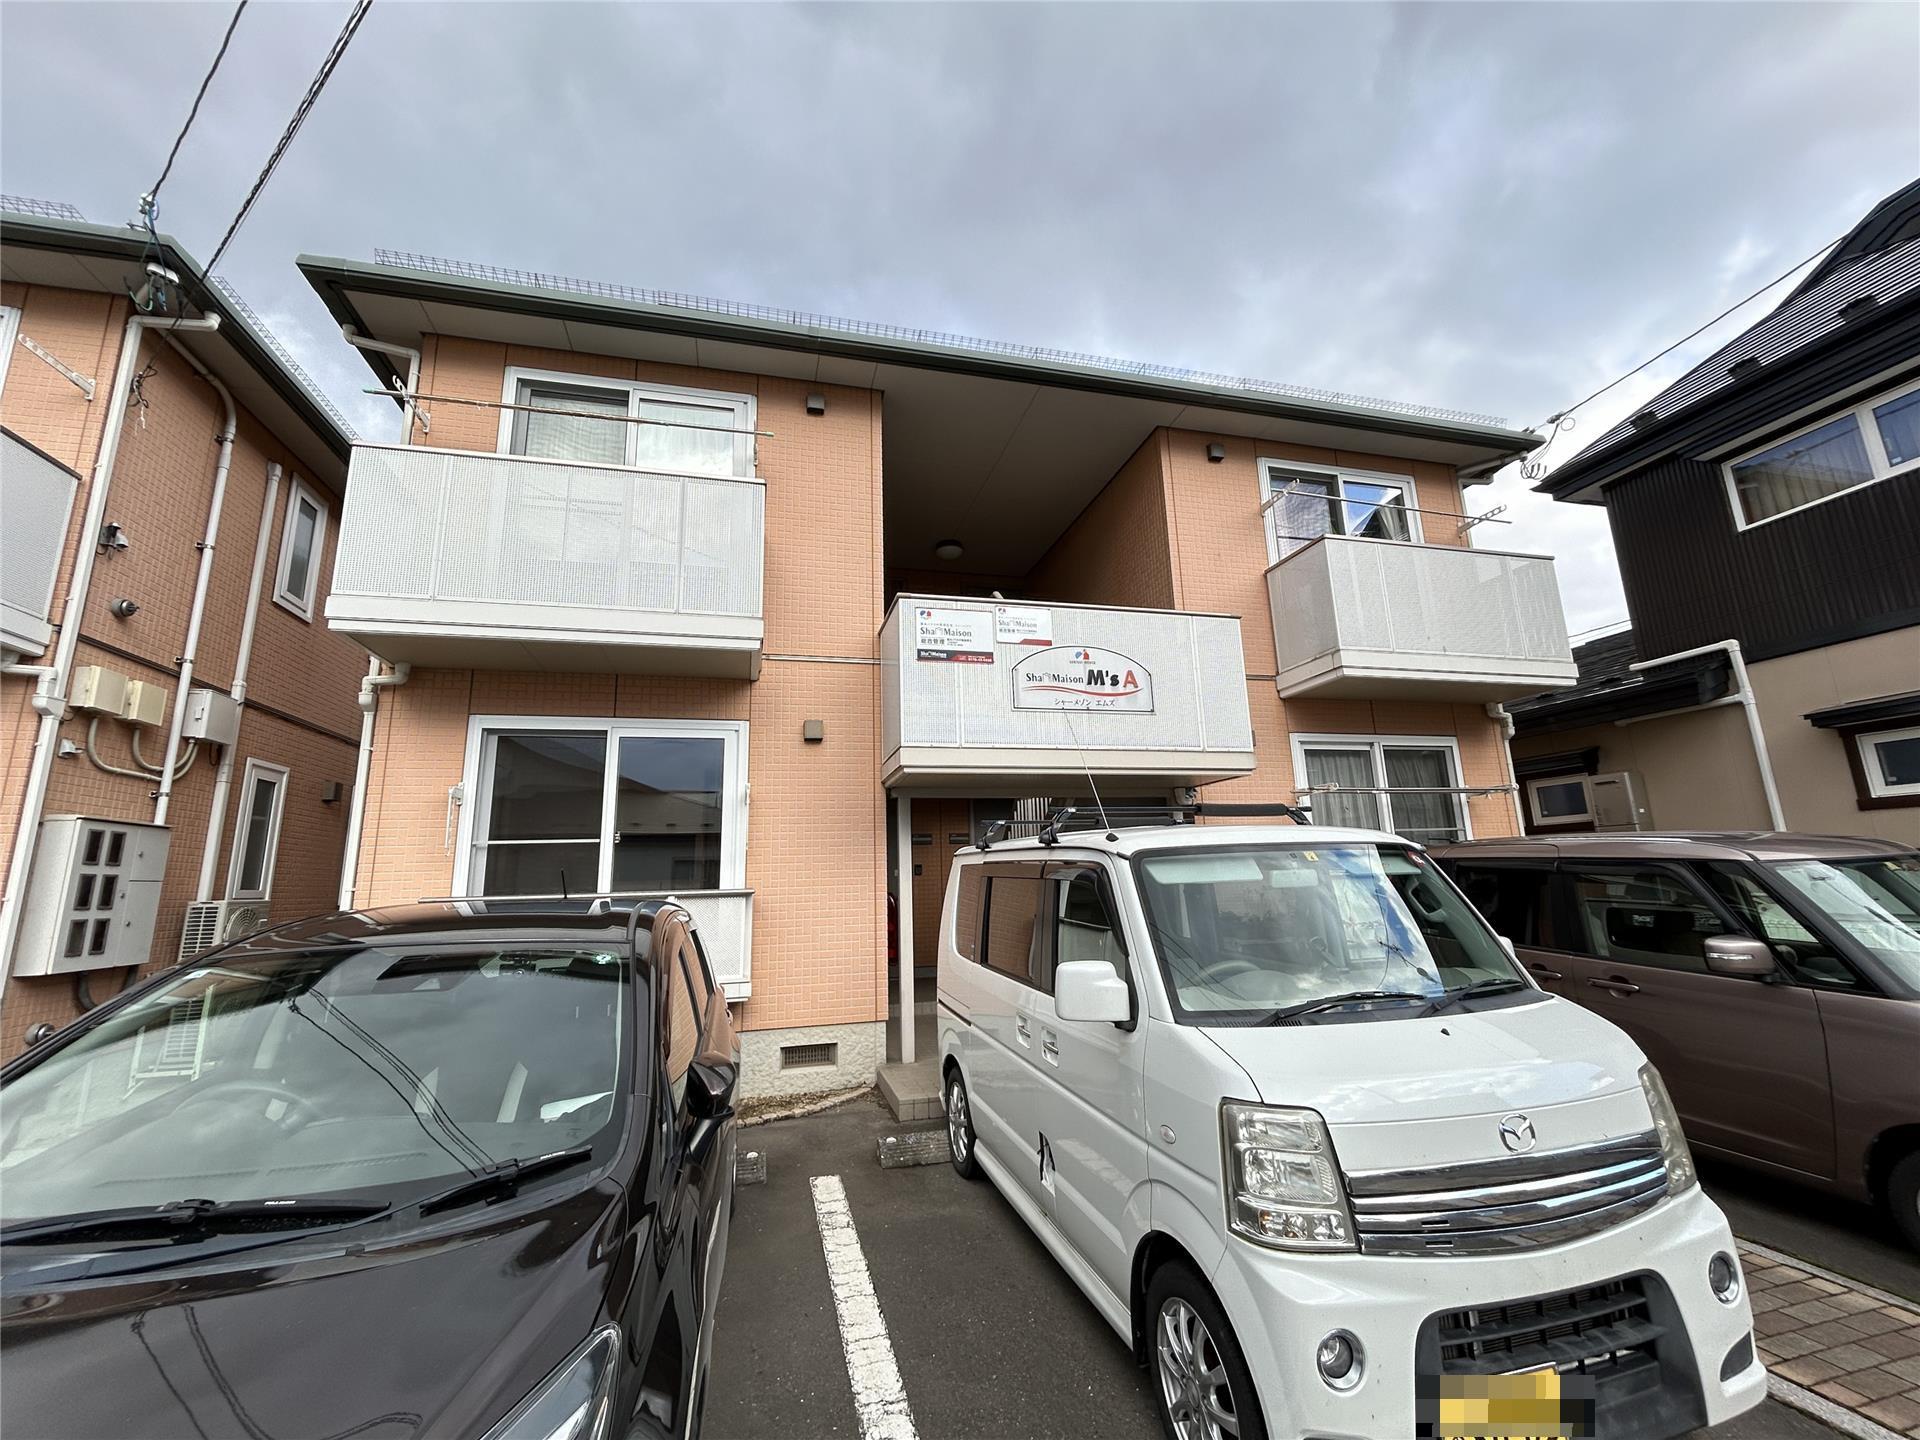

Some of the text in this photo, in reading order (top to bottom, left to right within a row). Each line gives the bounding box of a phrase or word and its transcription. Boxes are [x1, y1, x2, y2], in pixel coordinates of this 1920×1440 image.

[920, 627, 972, 637] Sha Maison
[1026, 669, 1139, 688] Sha Maison M's A
